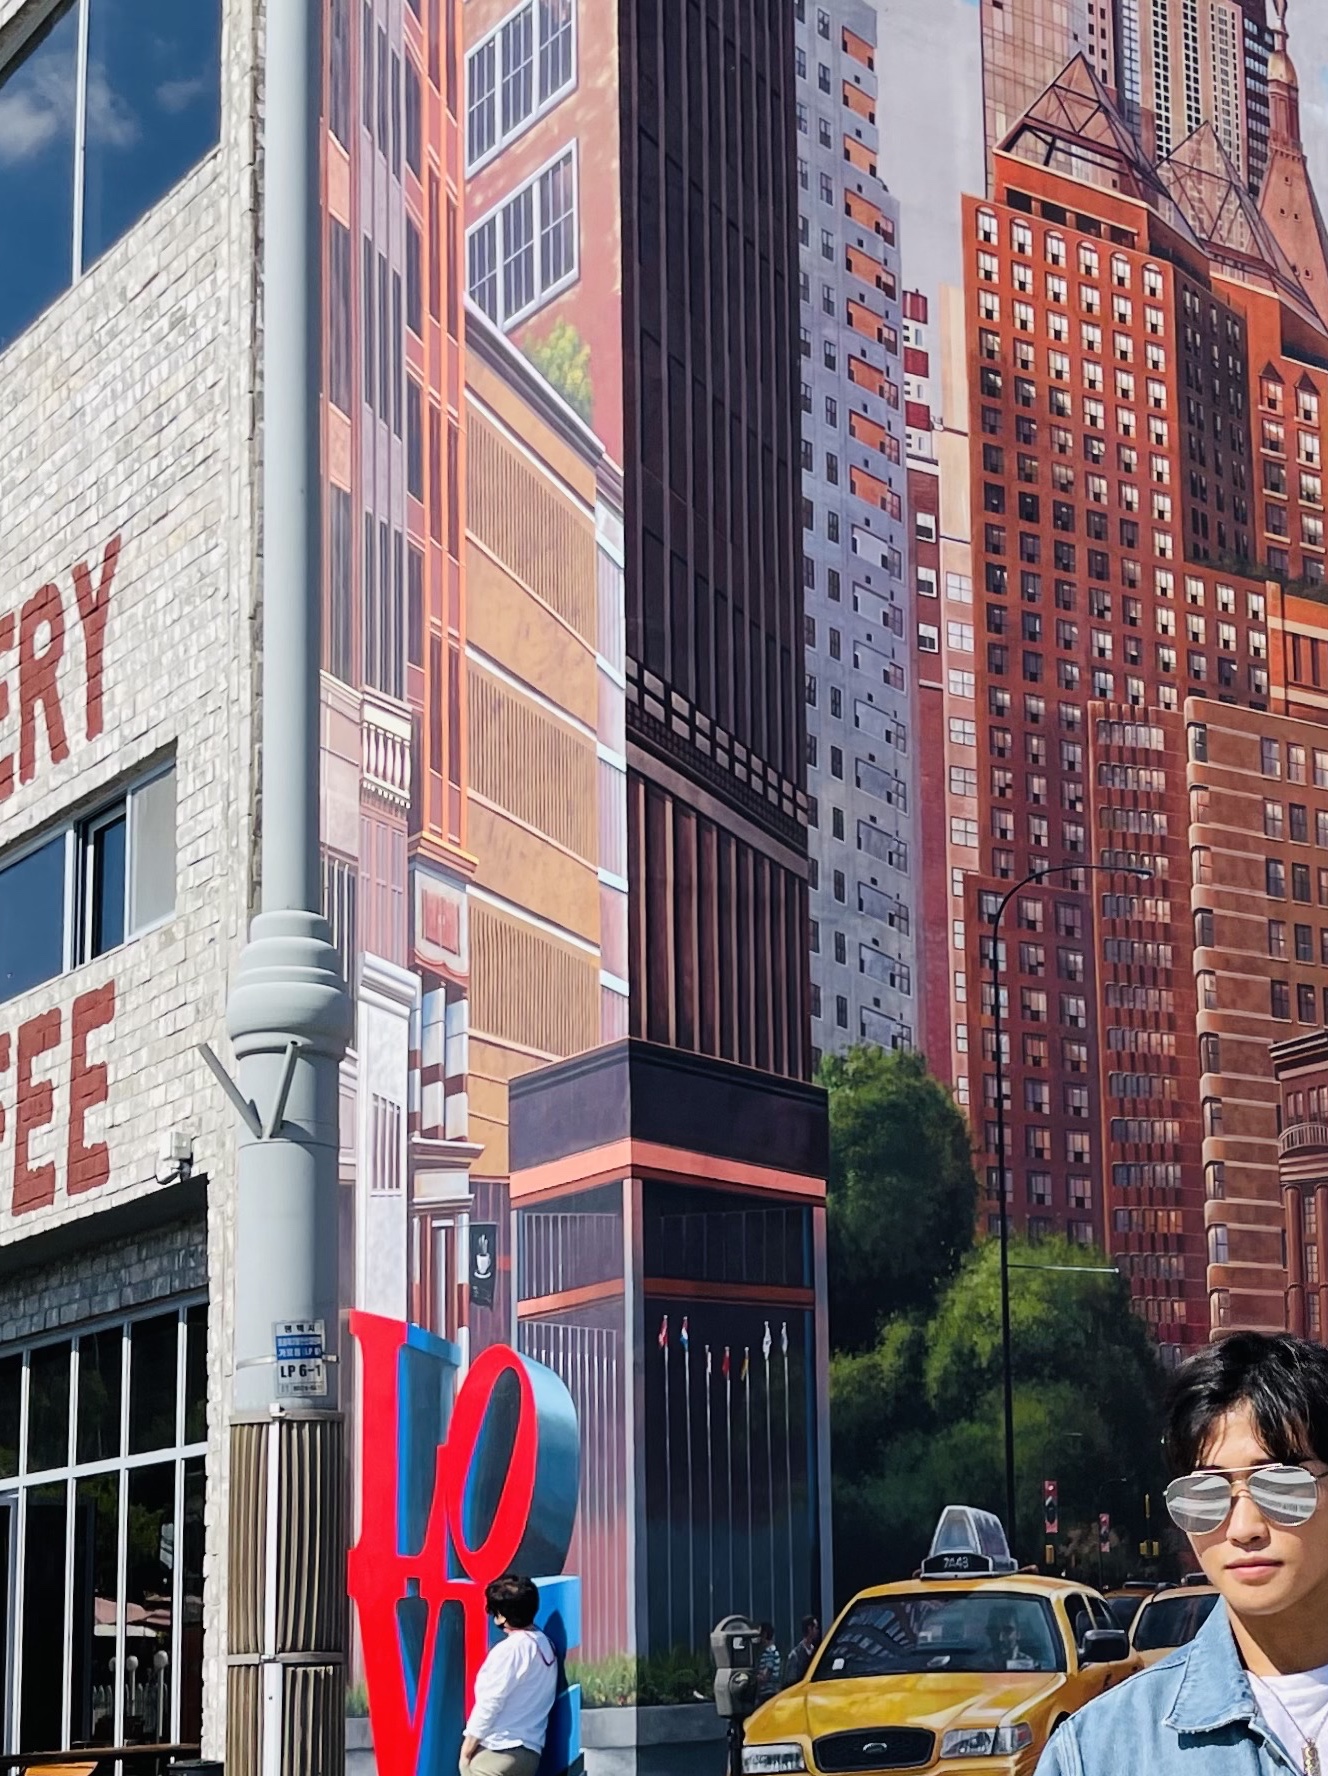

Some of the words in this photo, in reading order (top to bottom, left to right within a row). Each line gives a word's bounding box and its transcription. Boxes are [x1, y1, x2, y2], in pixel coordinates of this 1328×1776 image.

[0, 533, 122, 805] RY
[0, 979, 115, 1216] EE
[280, 1364, 296, 1378] LP
